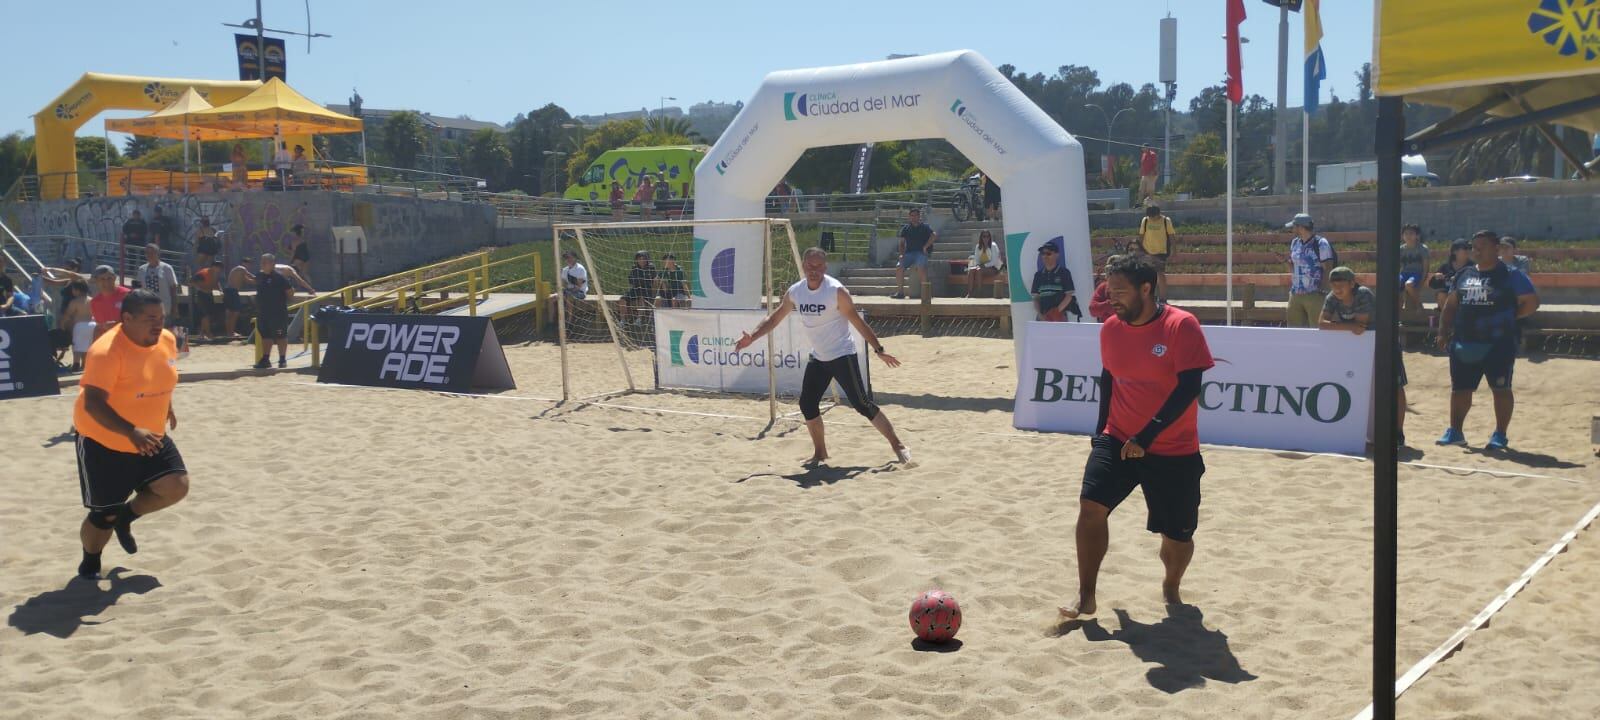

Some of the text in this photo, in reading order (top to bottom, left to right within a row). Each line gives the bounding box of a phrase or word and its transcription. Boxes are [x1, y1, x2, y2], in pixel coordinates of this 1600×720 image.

[809, 93, 921, 117] Ciudad del Mar
[800, 303, 826, 313] MCP
[345, 322, 460, 354] POWER
[379, 352, 450, 384] ADE
[702, 348, 801, 369] Ciudad del
[1029, 367, 1352, 423] BECTINO
